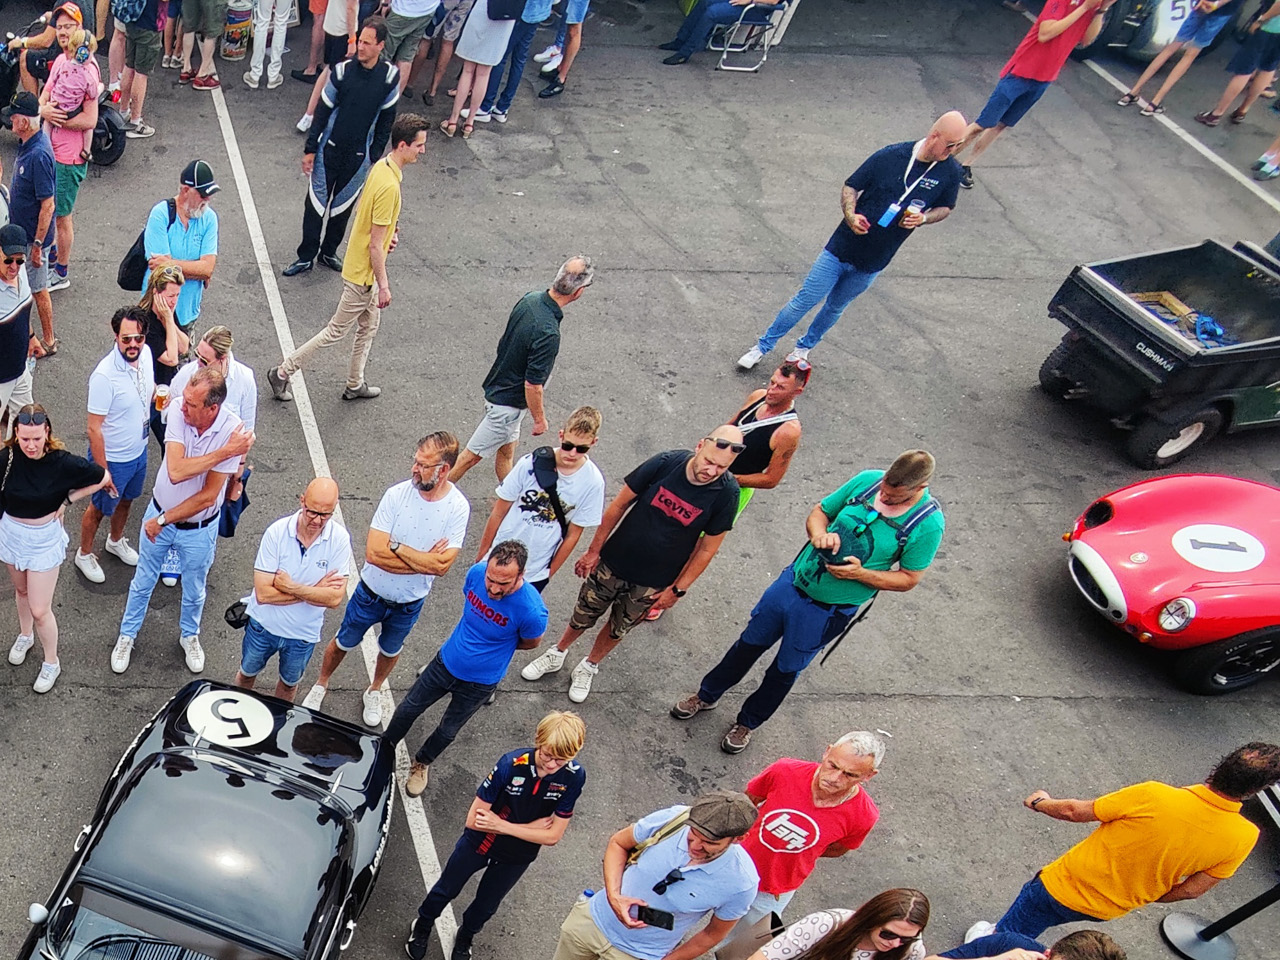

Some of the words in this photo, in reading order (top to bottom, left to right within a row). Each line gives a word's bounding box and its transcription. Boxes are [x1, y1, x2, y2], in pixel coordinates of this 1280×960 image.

[1135, 341, 1175, 371] CUSHMAN
[1189, 538, 1248, 553] 1
[467, 589, 510, 627] RUMORS
[210, 697, 252, 740] 5
